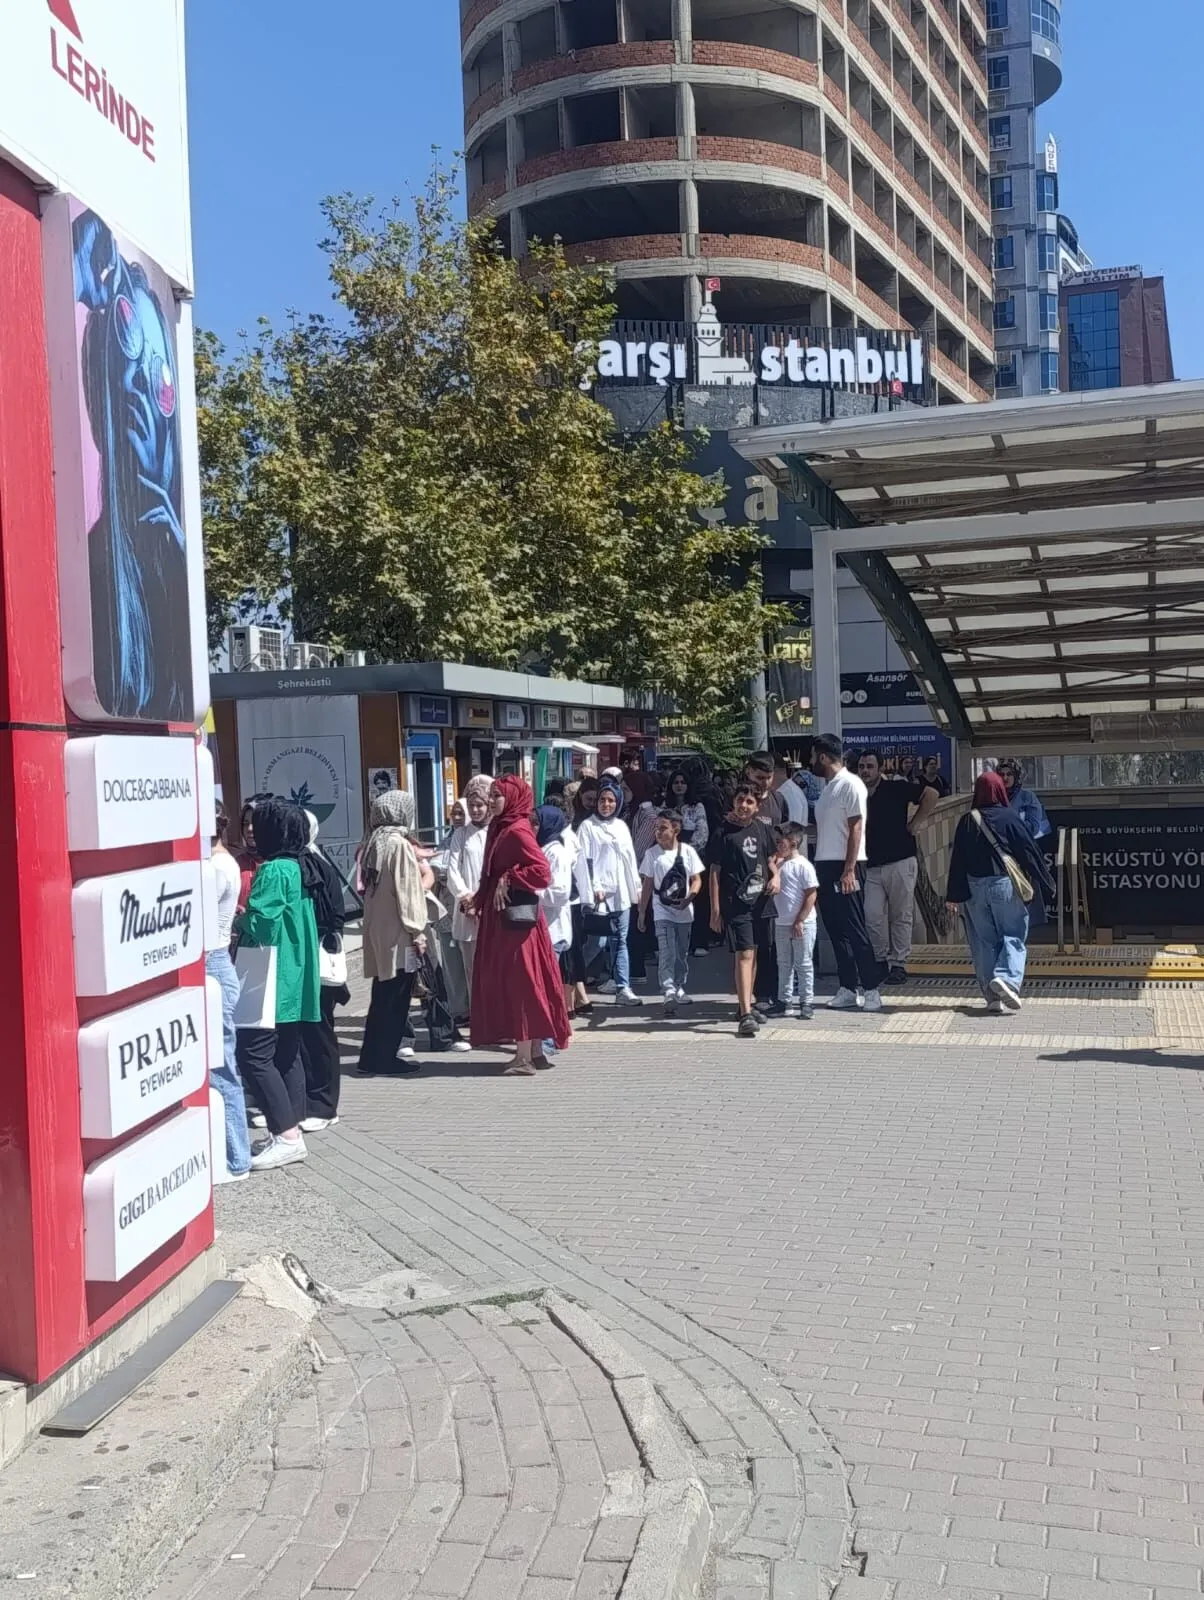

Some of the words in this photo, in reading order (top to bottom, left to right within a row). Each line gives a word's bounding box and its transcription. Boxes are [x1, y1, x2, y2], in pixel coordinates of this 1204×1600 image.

[50, 26, 155, 162] LERİNDE
[277, 678, 331, 689] Şehreküstü
[866, 673, 908, 683] Asansör
[103, 777, 192, 802] DOLCE&GABBANA
[1076, 826, 1102, 834] URSA
[1043, 848, 1166, 869] ŞREKÜSTÜ
[1093, 871, 1201, 889] İSTASYONU
[120, 881, 193, 947] Mustang
[143, 943, 178, 967] EYEWEAR
[118, 1013, 199, 1080] PRADA
[139, 1060, 183, 1098] EYEWEAR
[118, 1192, 146, 1230] GIGI
[146, 1150, 208, 1210] BARCELONA
